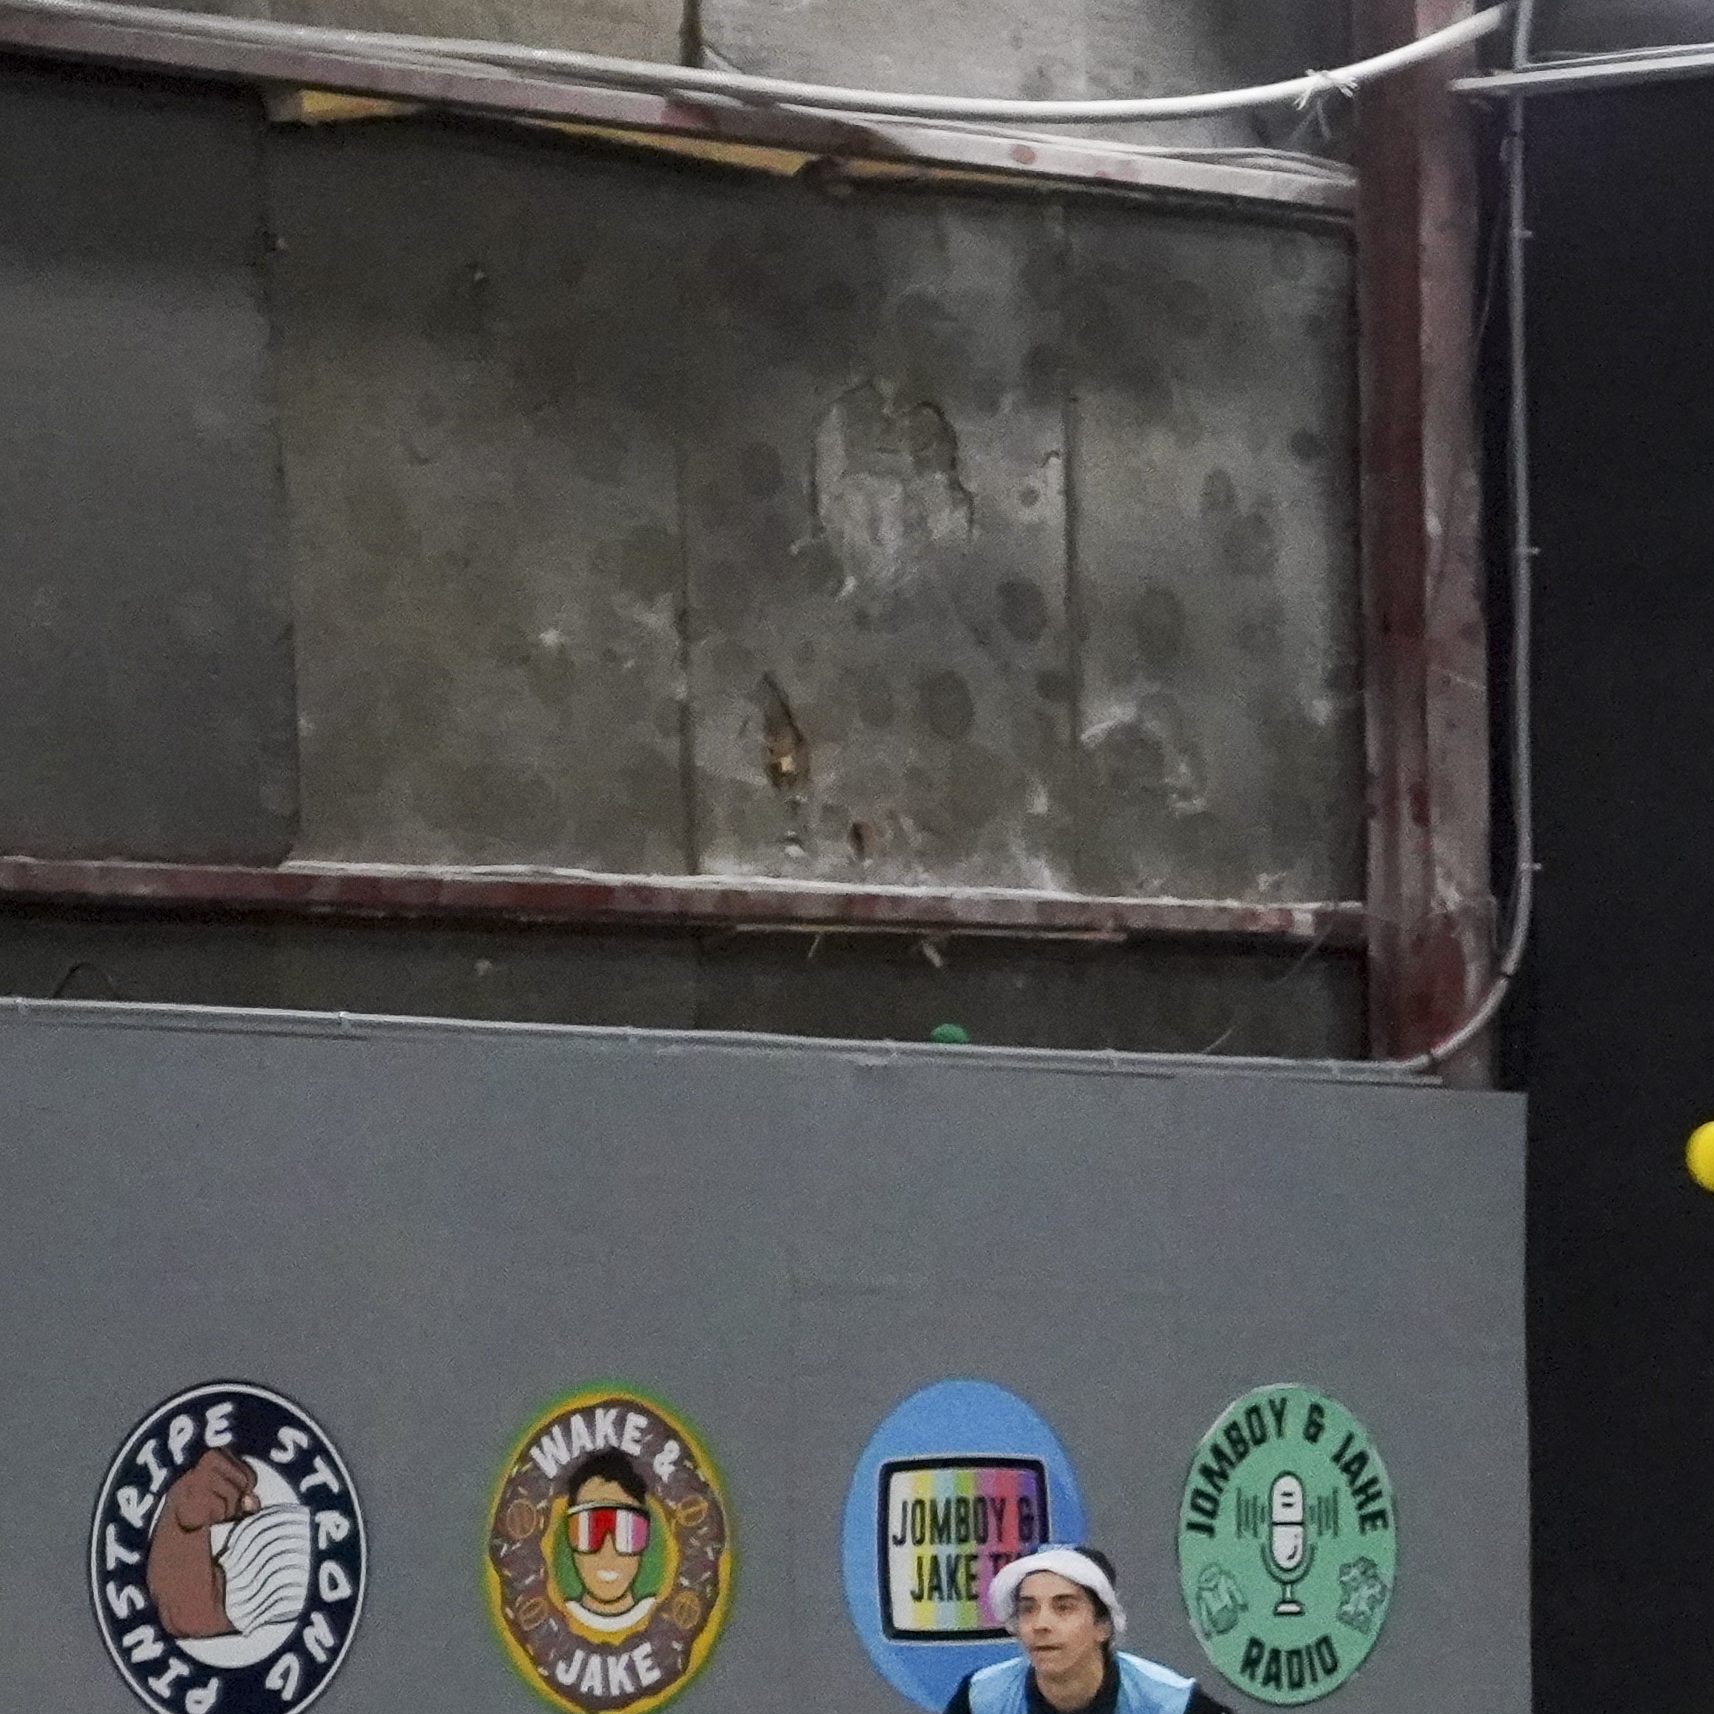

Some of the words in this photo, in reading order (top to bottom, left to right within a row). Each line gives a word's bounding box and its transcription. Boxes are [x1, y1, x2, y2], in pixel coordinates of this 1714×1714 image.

[530, 1407, 650, 1478] WAKE
[652, 1440, 683, 1482] &
[1186, 1397, 1288, 1539] JOMBOY
[1331, 1431, 1390, 1535] JAKE
[892, 1495, 1007, 1547] JOMBOY
[265, 1426, 353, 1701] STRONG
[910, 1552, 980, 1602] JAKE
[556, 1641, 661, 1697] JAKE
[1240, 1634, 1340, 1692] RADIO
